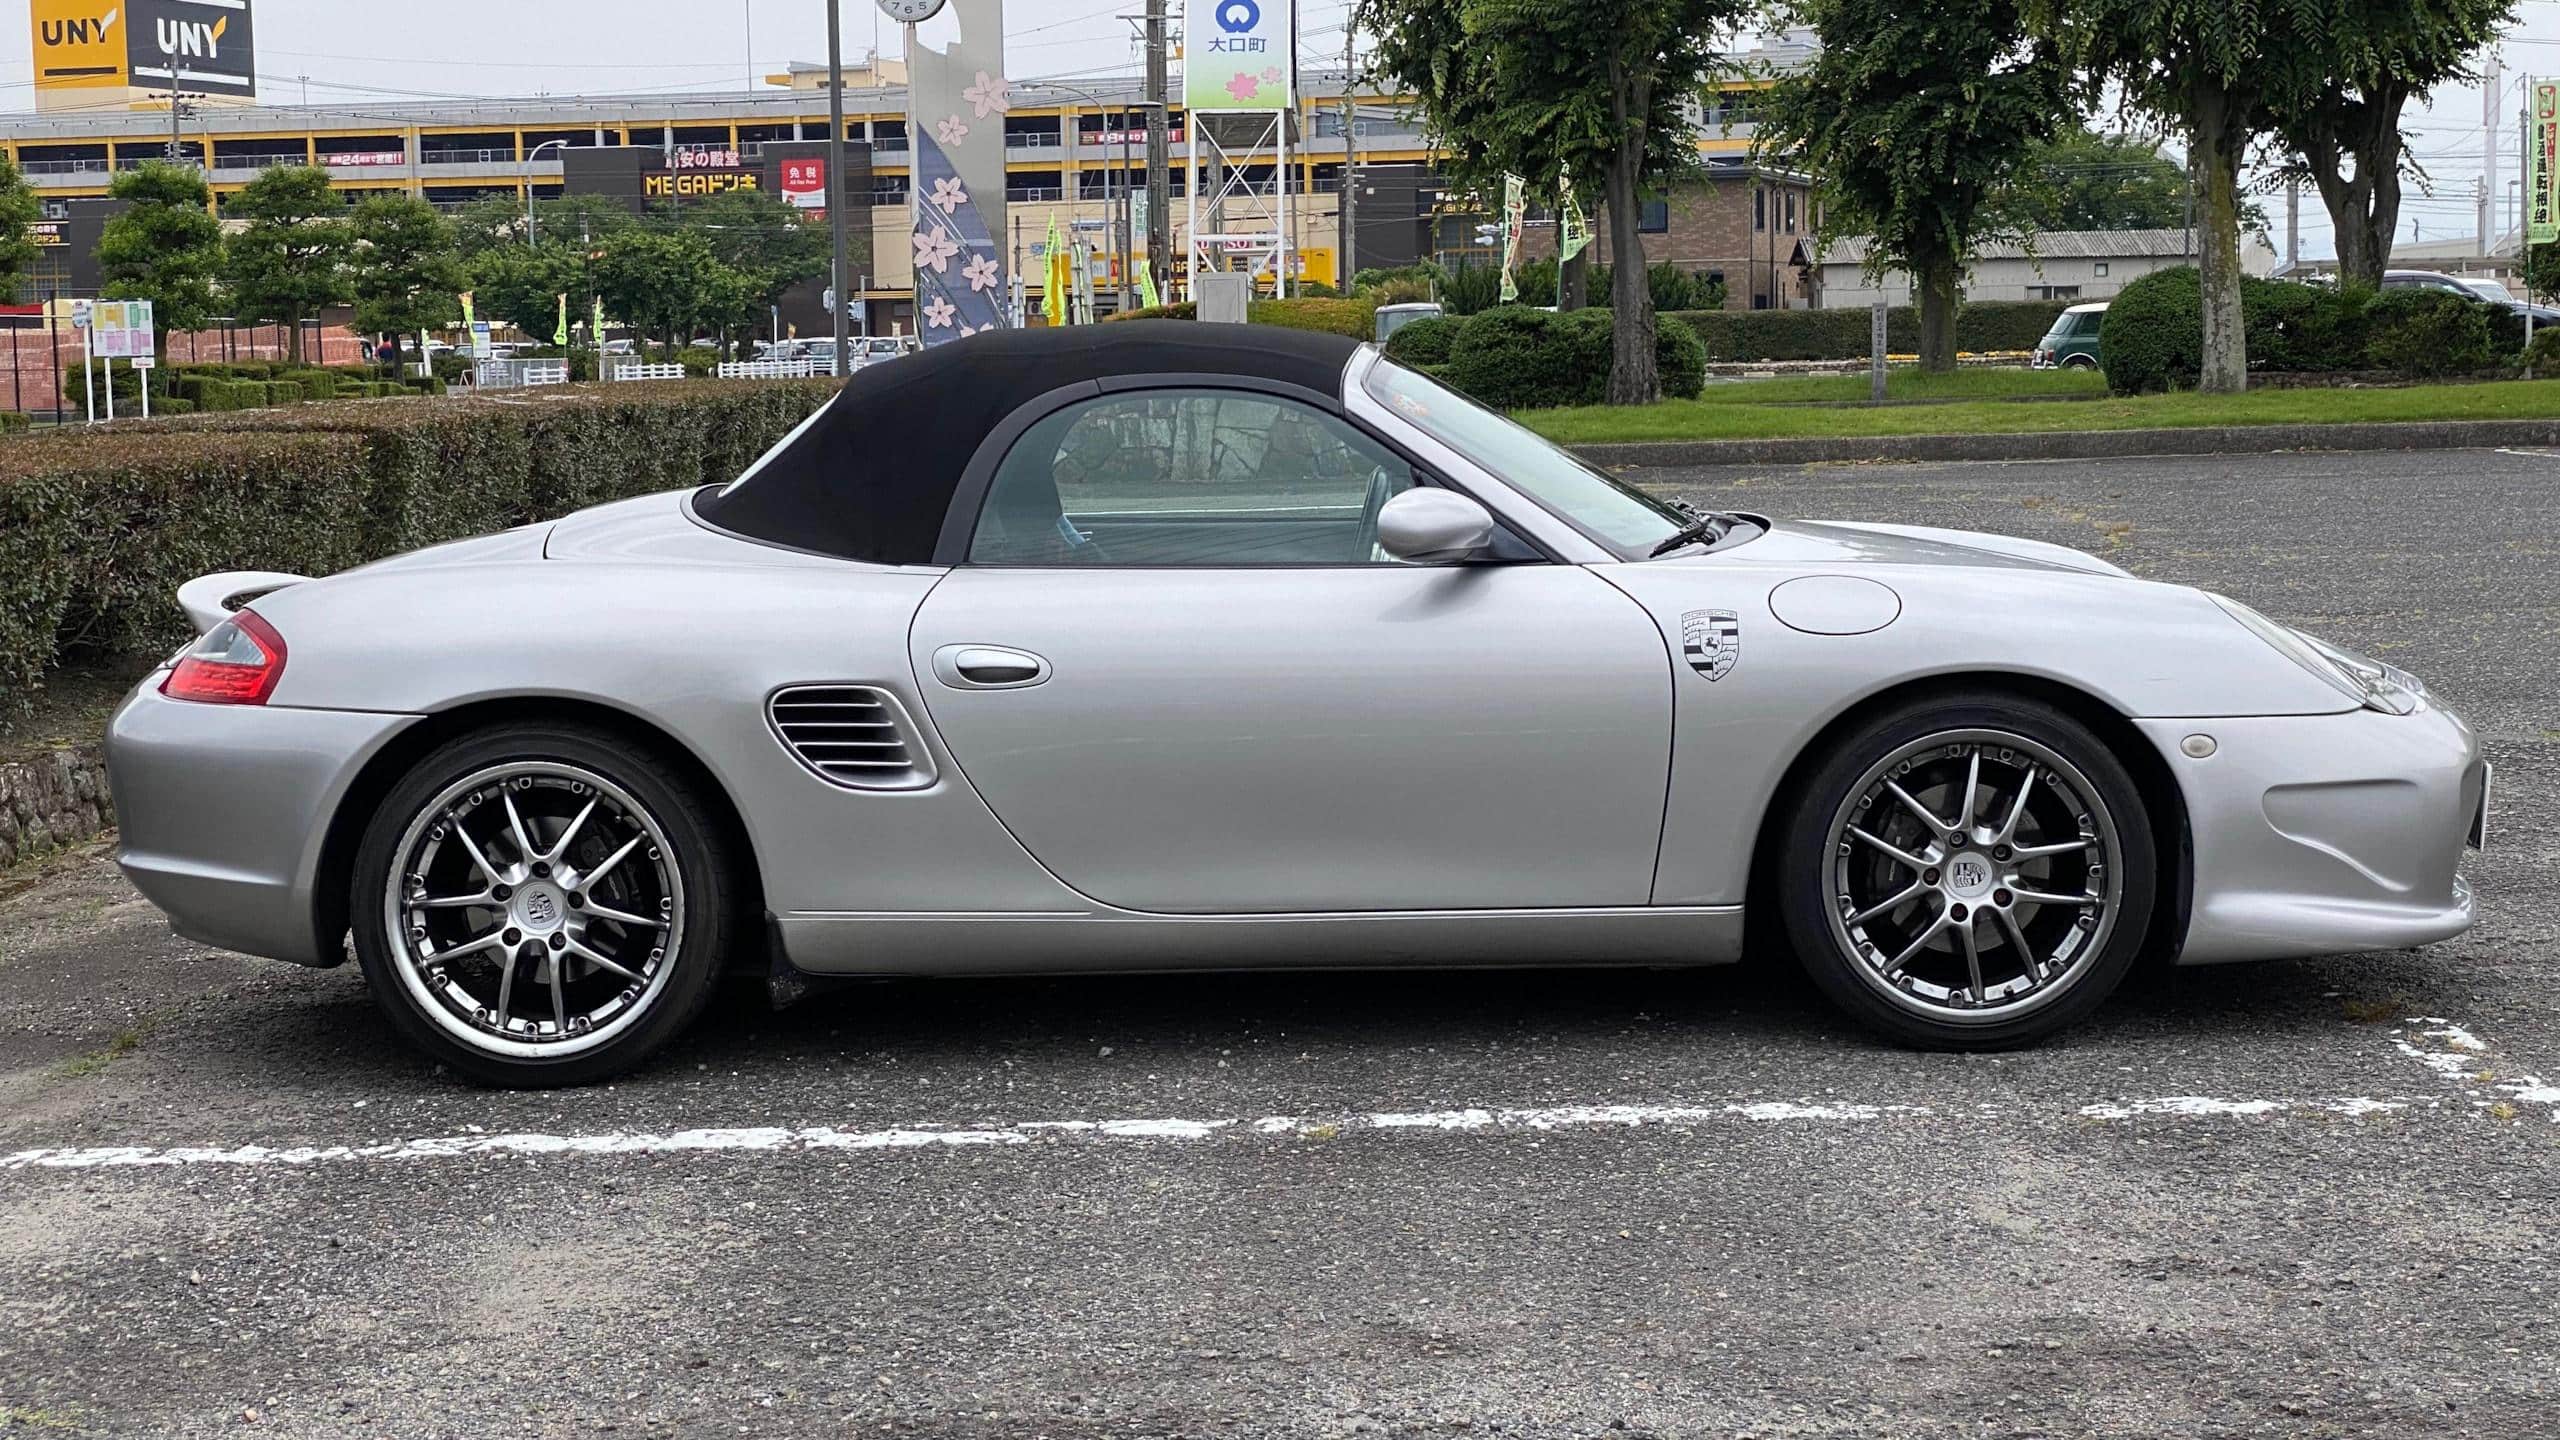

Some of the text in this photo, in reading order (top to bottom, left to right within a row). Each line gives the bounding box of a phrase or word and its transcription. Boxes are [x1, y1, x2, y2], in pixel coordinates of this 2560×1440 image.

[892, 2, 900, 10] 7
[904, 6, 913, 14] 6
[918, 2, 927, 10] 5
[42, 8, 117, 46] UNY
[157, 15, 227, 58] UNY
[1208, 37, 1267, 53] 大口町
[645, 173, 757, 196] MEGAドンキ
